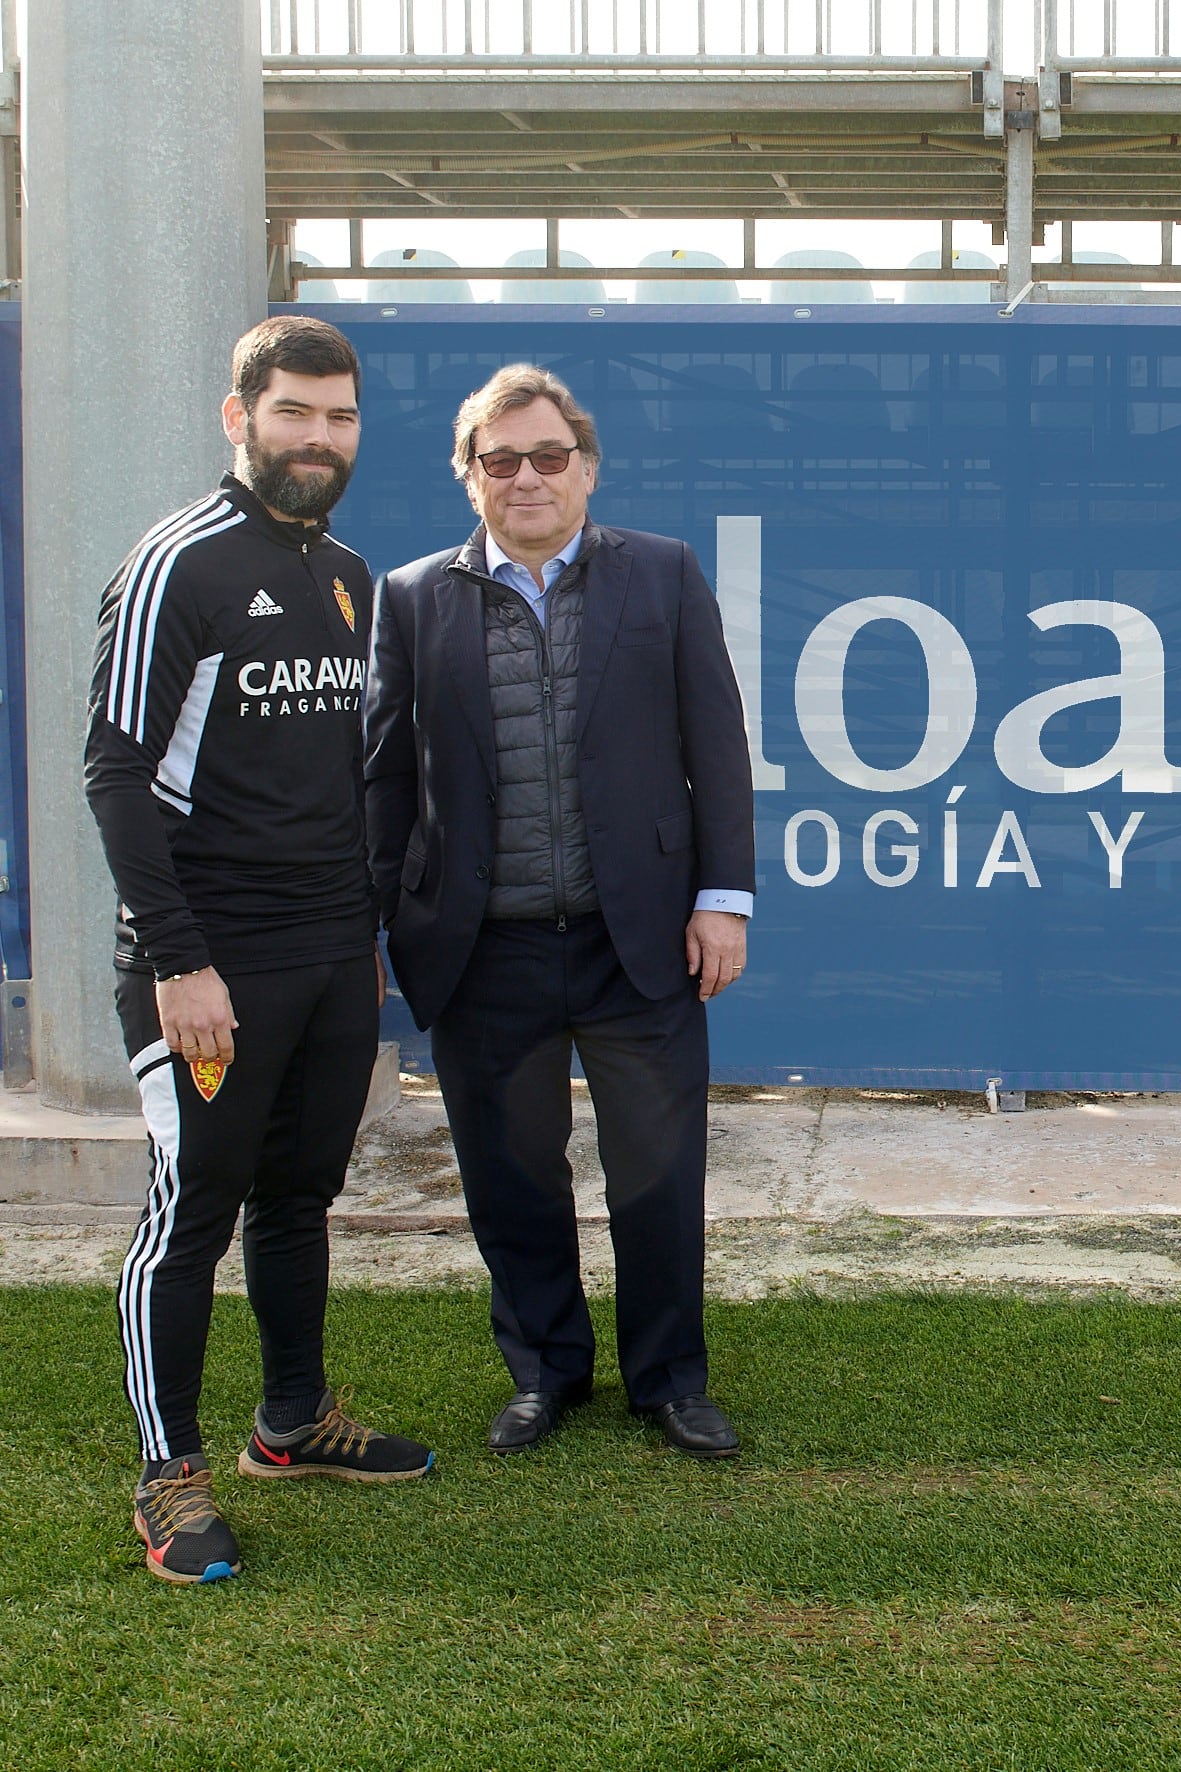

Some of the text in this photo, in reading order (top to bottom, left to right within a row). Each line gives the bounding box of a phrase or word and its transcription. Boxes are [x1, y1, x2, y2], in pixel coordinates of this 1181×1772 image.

[247, 604, 284, 617] adidas
[238, 656, 366, 696] CARAVA
[240, 695, 360, 717] FRAGANCI
[783, 785, 1042, 889] OGÍA
[1087, 811, 1146, 889] Y
